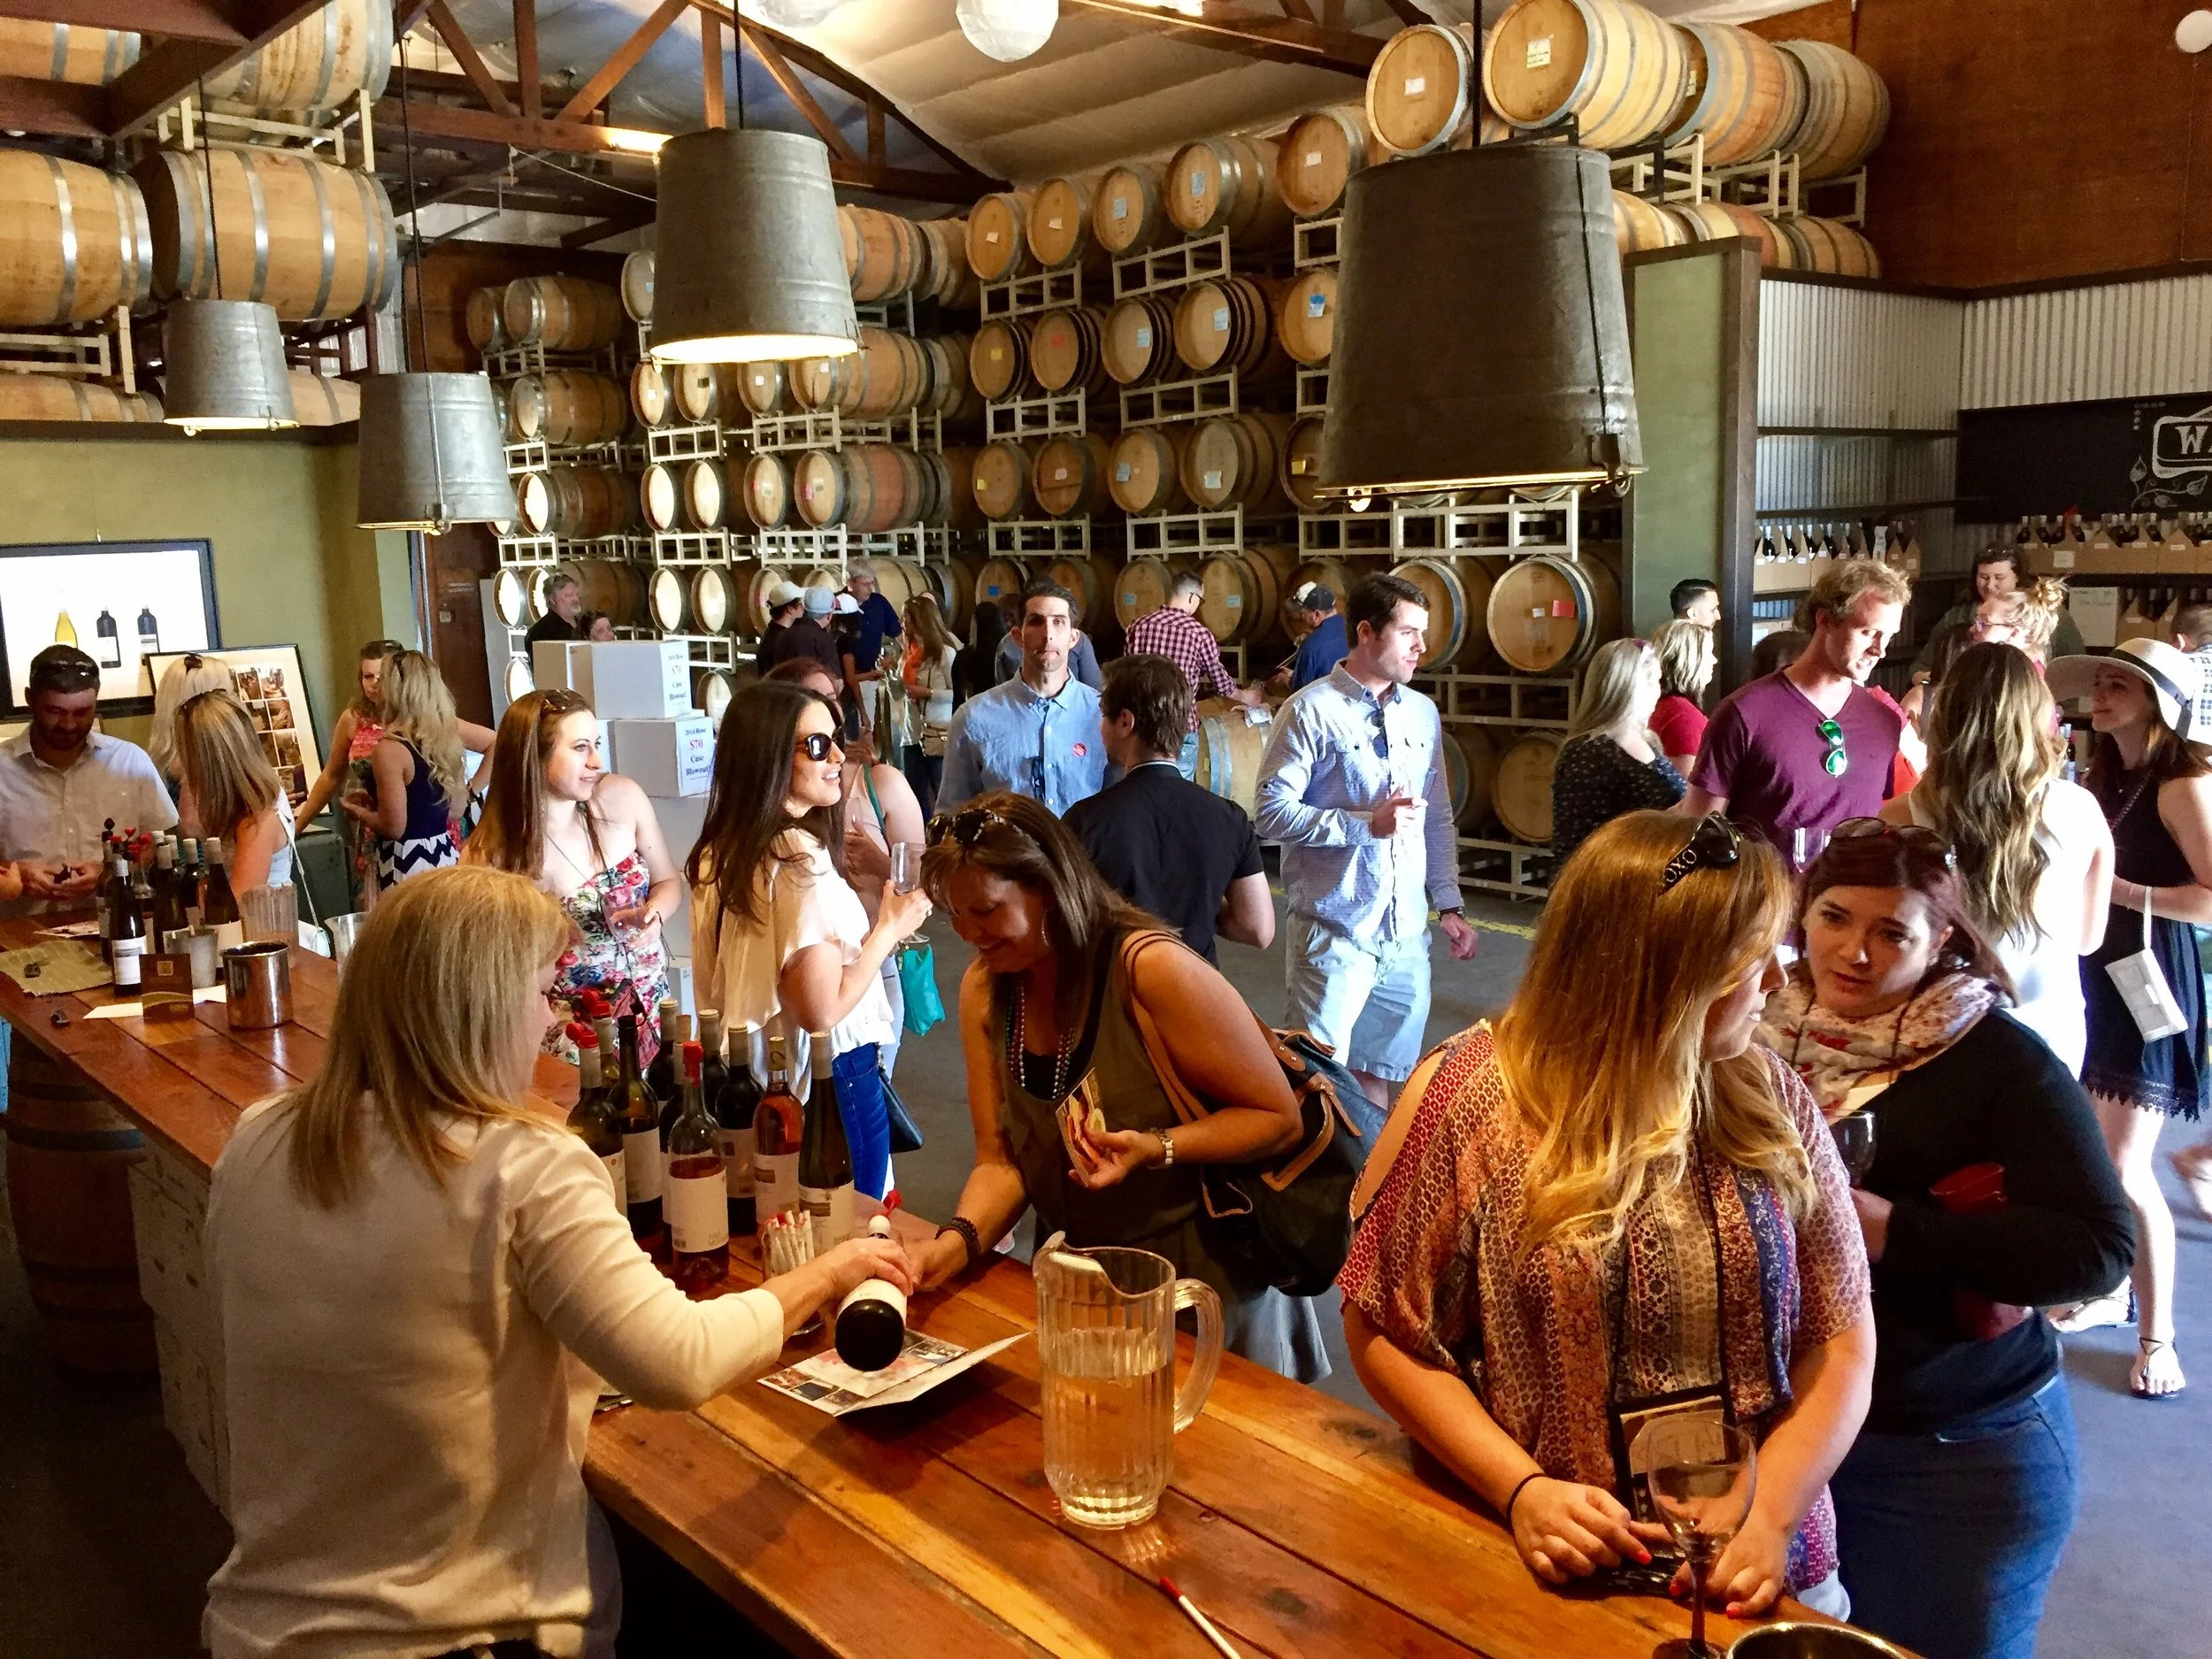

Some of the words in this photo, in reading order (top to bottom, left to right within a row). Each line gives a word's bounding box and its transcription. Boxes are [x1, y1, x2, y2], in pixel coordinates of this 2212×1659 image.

[2175, 426, 2212, 454] W
[690, 739, 703, 751] $70
[690, 755, 704, 764] Case
[686, 764, 711, 776] Blowout!
